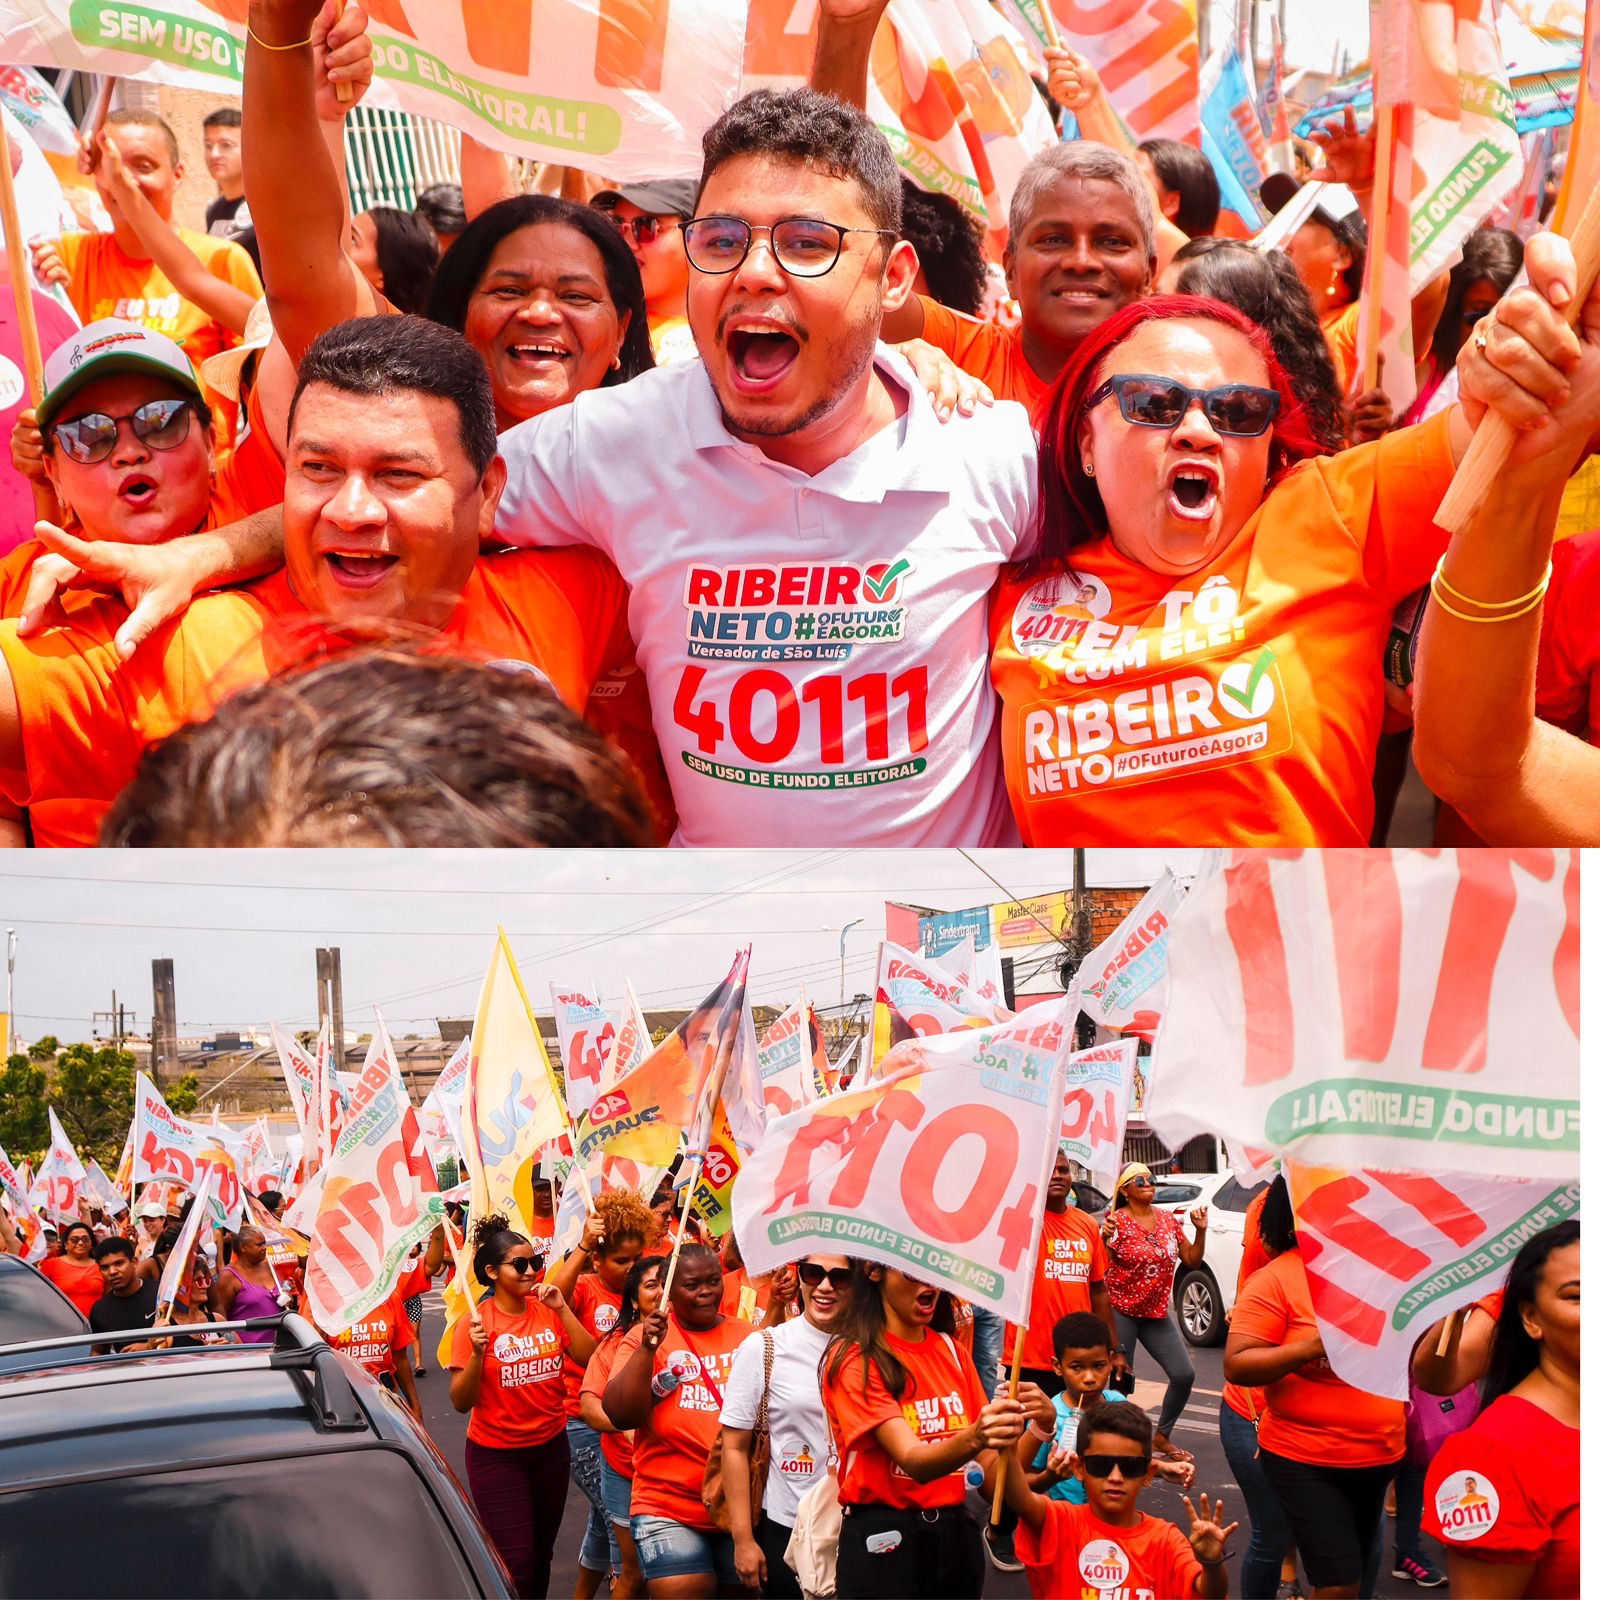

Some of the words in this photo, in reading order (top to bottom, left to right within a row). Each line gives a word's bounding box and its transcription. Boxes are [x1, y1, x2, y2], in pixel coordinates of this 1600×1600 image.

[99, 9, 166, 48] SEM
[173, 23, 231, 66] USO
[417, 53, 587, 141] ELEITORAL!
[912, 151, 938, 177] DE
[1158, 574, 1241, 634] TÔ
[690, 611, 792, 641] NETO
[1159, 617, 1246, 662] ELE!
[691, 643, 759, 660] Vereador
[761, 645, 780, 659] de
[783, 644, 813, 660] São
[816, 645, 847, 660] Luís
[594, 683, 621, 696] ora
[673, 664, 930, 764] 40111
[687, 756, 713, 776] SEM
[715, 766, 746, 783] USO
[749, 771, 770, 787] DE
[773, 774, 831, 788] FUNDO
[834, 764, 918, 787] ELEITORAL
[1027, 753, 1113, 796] NETO
[1007, 902, 1048, 919] MasterClass
[705, 1151, 732, 1184] 40
[693, 1183, 723, 1218] RTE
[1072, 1237, 1087, 1252] TÔ
[1054, 1250, 1073, 1259] COM
[370, 1320, 387, 1332] TÔ
[352, 1333, 371, 1342] COM
[535, 1328, 556, 1345] TÔ
[501, 1377, 527, 1388] NETO
[680, 1399, 707, 1410] NETO
[902, 1396, 940, 1434] #EU
[941, 1390, 964, 1416] TÔ
[920, 1417, 946, 1435] COM
[780, 1460, 813, 1474] 40111
[1441, 1502, 1492, 1531] 40111
[1083, 1564, 1123, 1581] 40111
